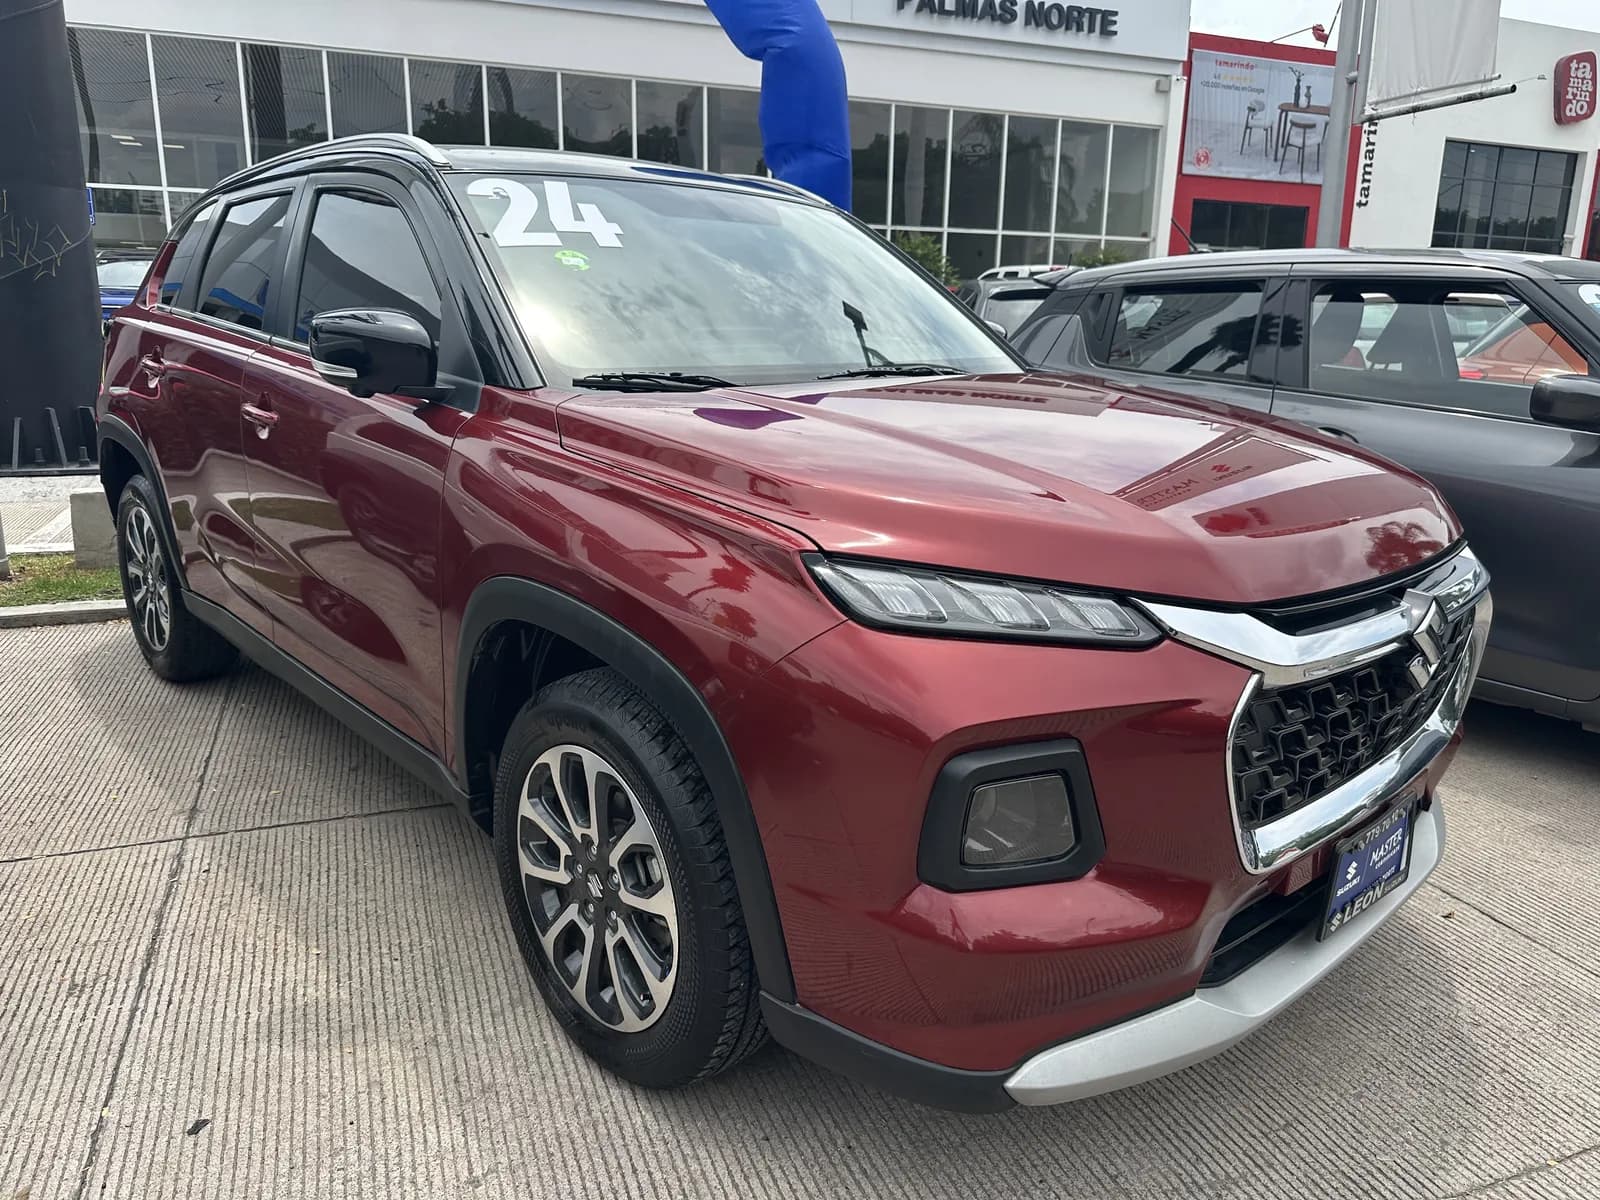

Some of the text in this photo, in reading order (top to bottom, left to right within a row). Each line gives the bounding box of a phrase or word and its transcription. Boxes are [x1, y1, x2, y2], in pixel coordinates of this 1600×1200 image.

[1024, 1, 1119, 36] NORTE
[467, 178, 624, 248] 24
[1370, 827, 1403, 867] MASTER
[1336, 875, 1361, 897] SUZUKI
[1343, 881, 1385, 925] LEON
